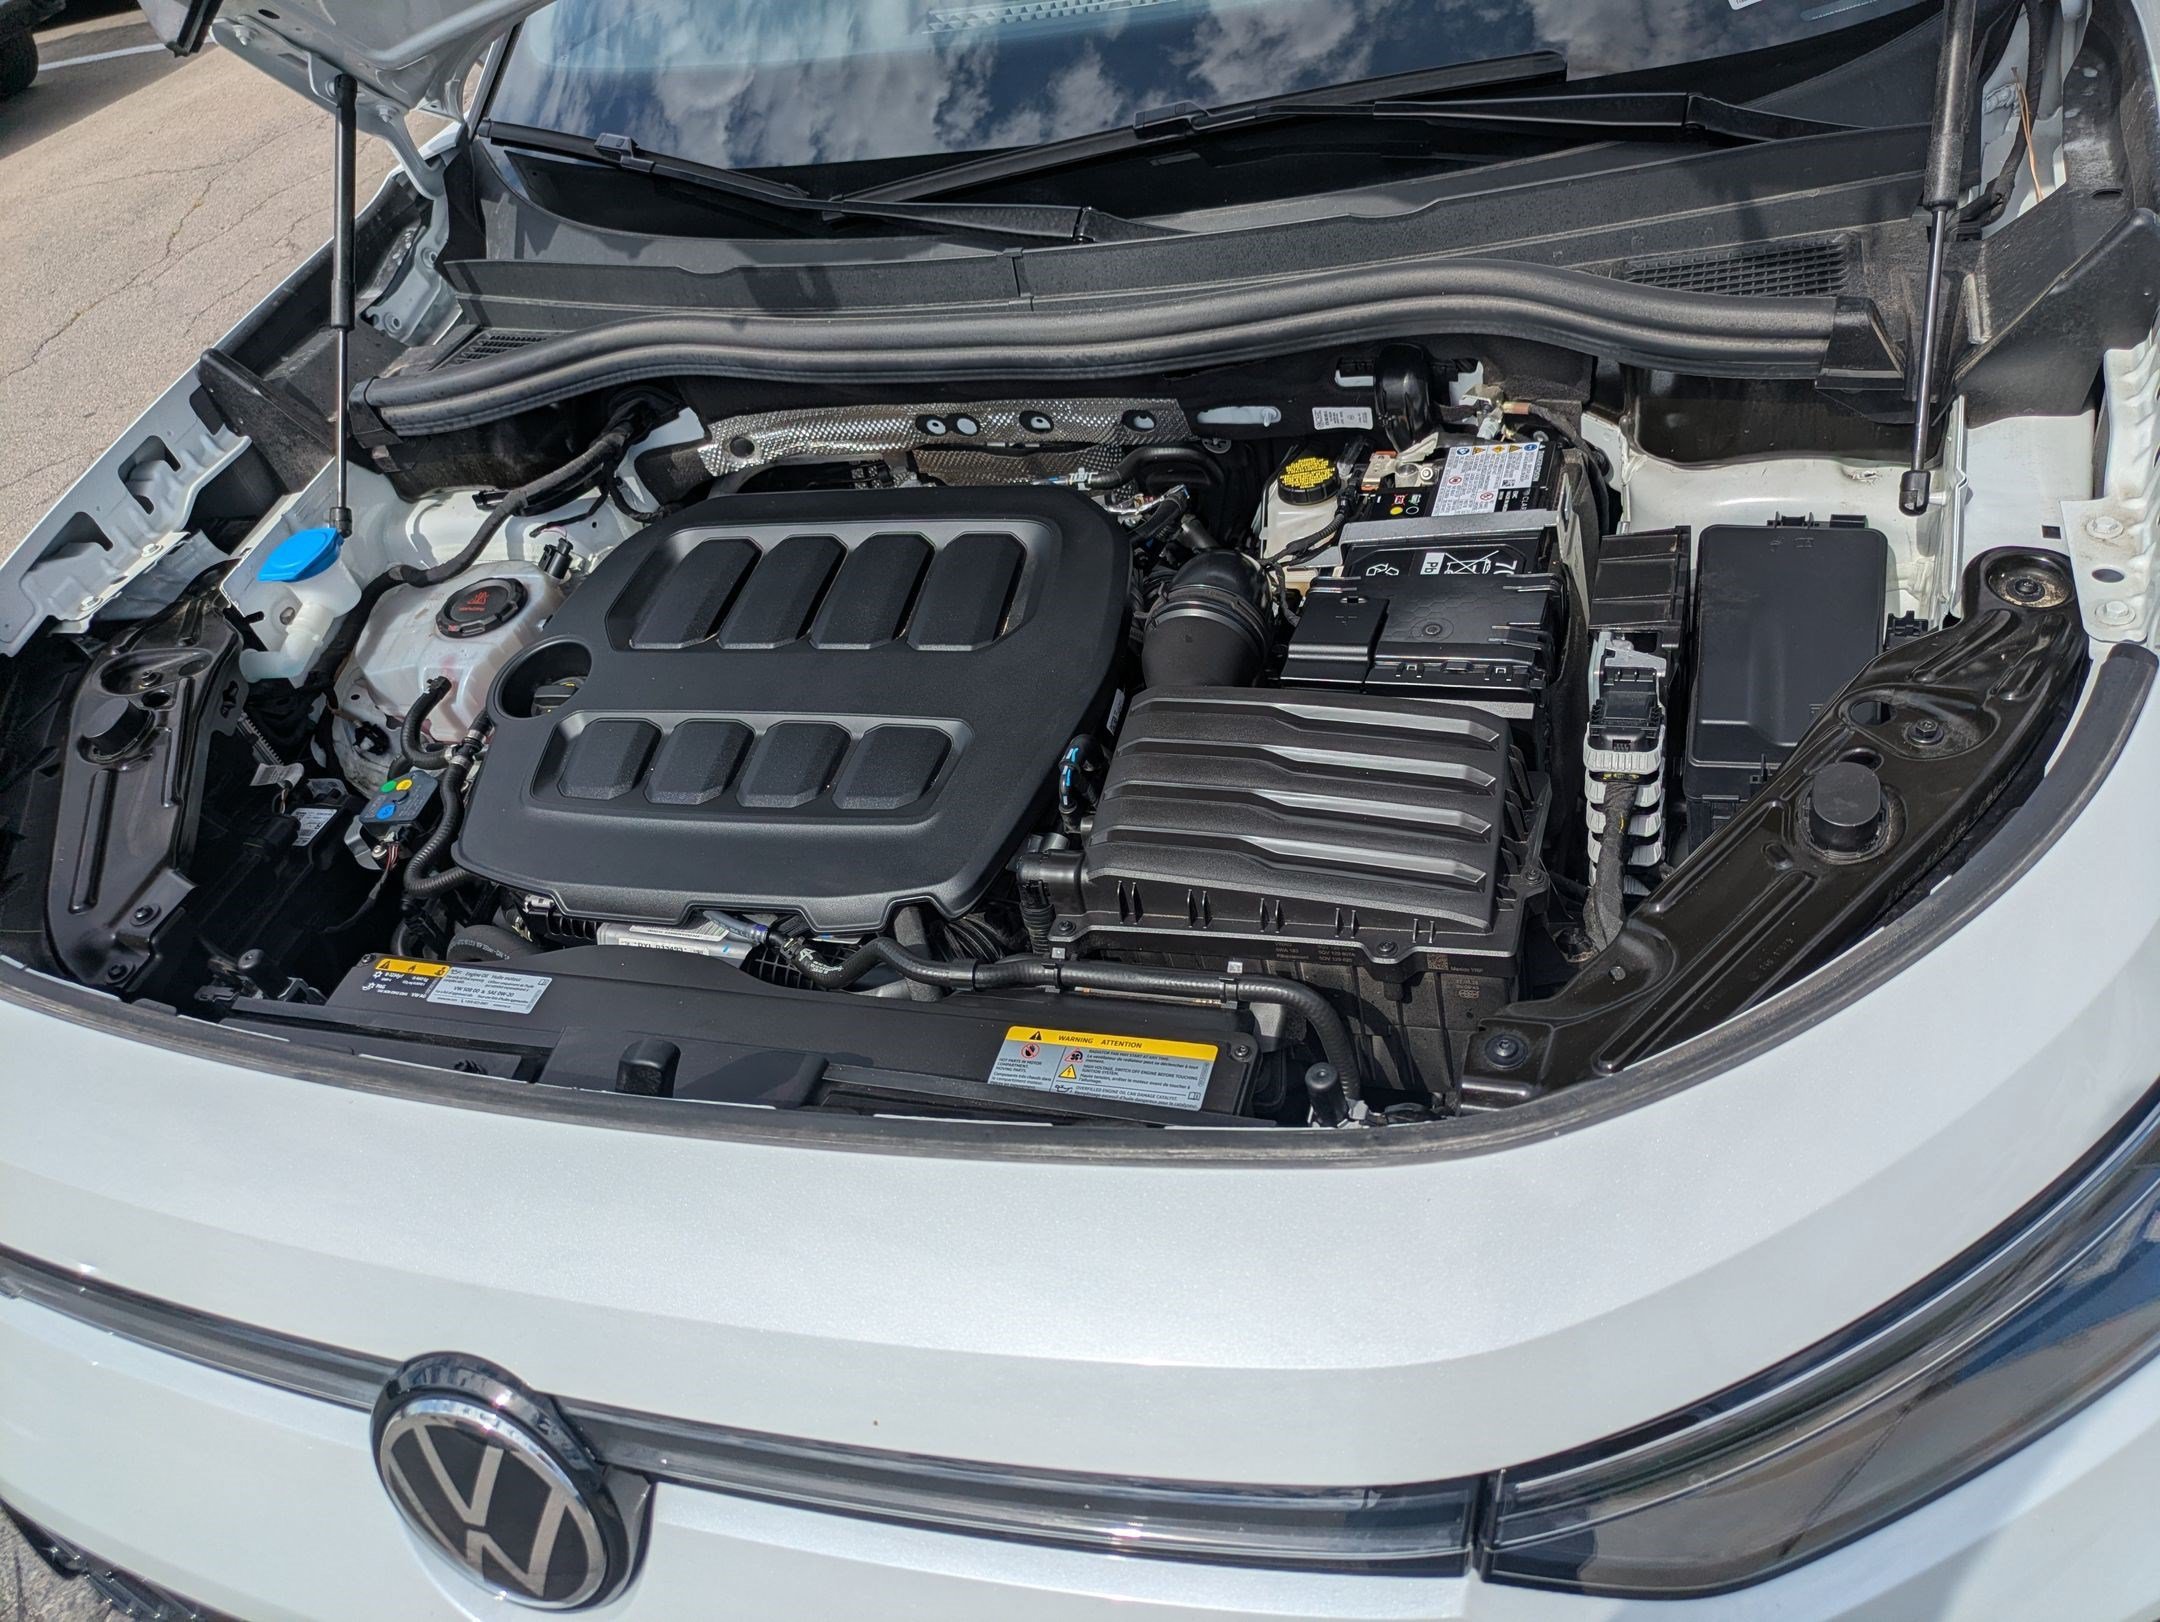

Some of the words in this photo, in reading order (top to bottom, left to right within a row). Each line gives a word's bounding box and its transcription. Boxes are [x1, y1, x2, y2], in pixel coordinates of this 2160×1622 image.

[1424, 561, 1439, 573] Pb
[1057, 1034, 1094, 1043] WARNING
[1100, 1038, 1142, 1048] ATTENTION
[380, 1398, 610, 1610] VW
